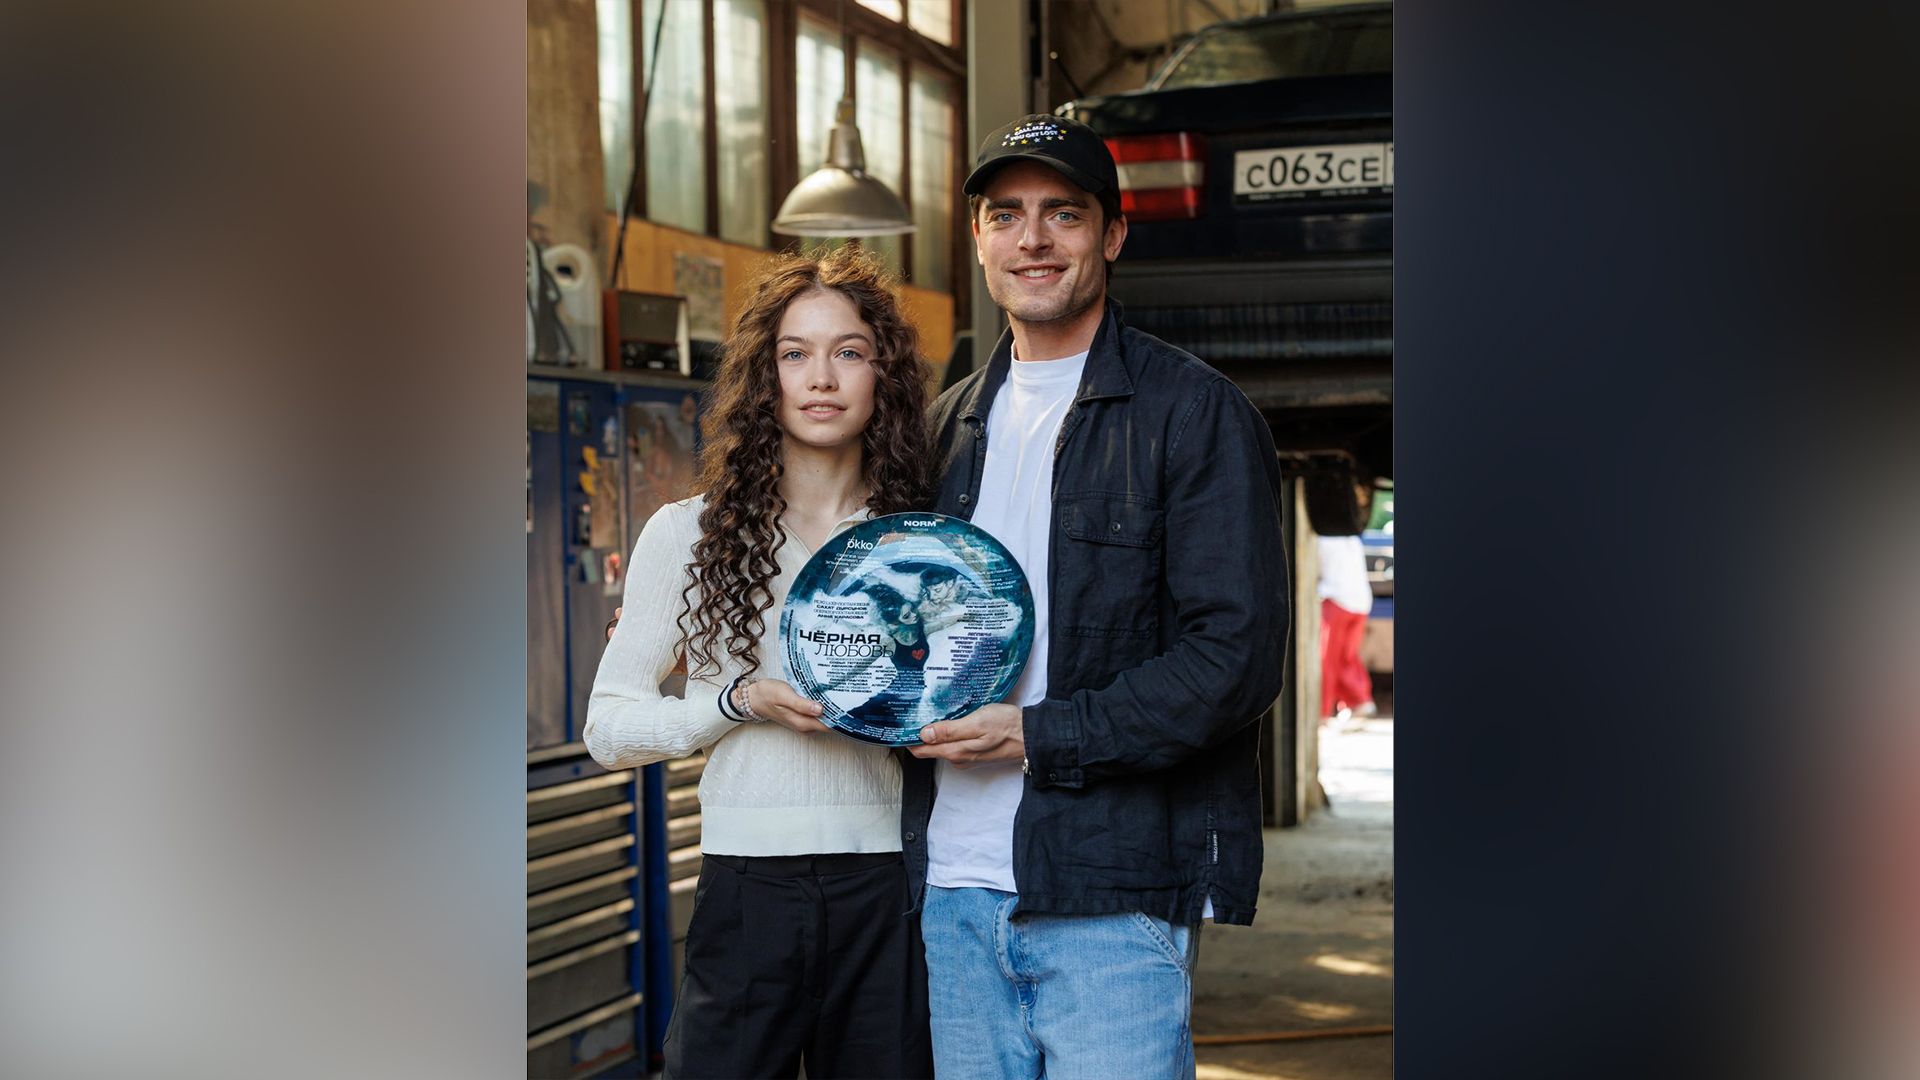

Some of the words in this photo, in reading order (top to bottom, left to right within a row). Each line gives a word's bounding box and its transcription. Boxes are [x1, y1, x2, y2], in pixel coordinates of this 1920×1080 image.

[1014, 128, 1031, 136] CALL
[800, 630, 881, 645] ЧЁРНАЯ
[814, 643, 894, 658] ЛЮБОВЬ
